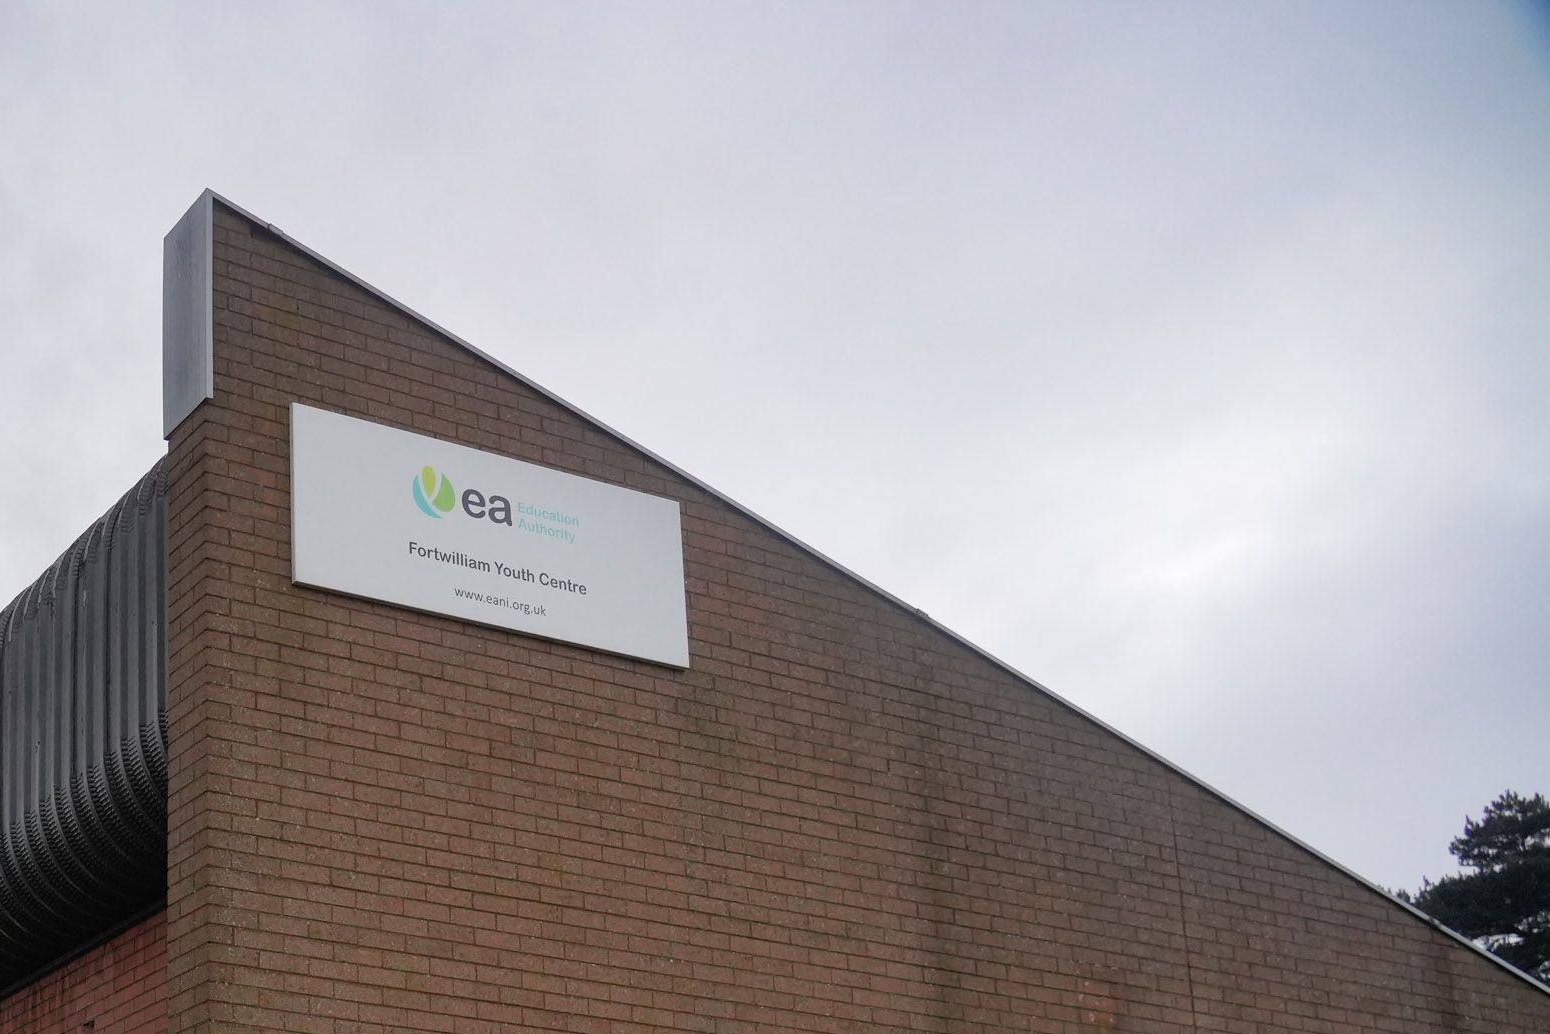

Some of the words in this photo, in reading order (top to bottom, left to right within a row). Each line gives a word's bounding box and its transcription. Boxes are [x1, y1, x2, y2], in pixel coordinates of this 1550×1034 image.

[461, 489, 513, 527] ea
[517, 502, 580, 528] Education
[518, 519, 576, 545] Authority
[409, 541, 491, 573] Fortwilliam
[494, 561, 535, 583] Youth
[539, 573, 587, 595] Centre
[454, 588, 547, 617] www.eani.org.uk
